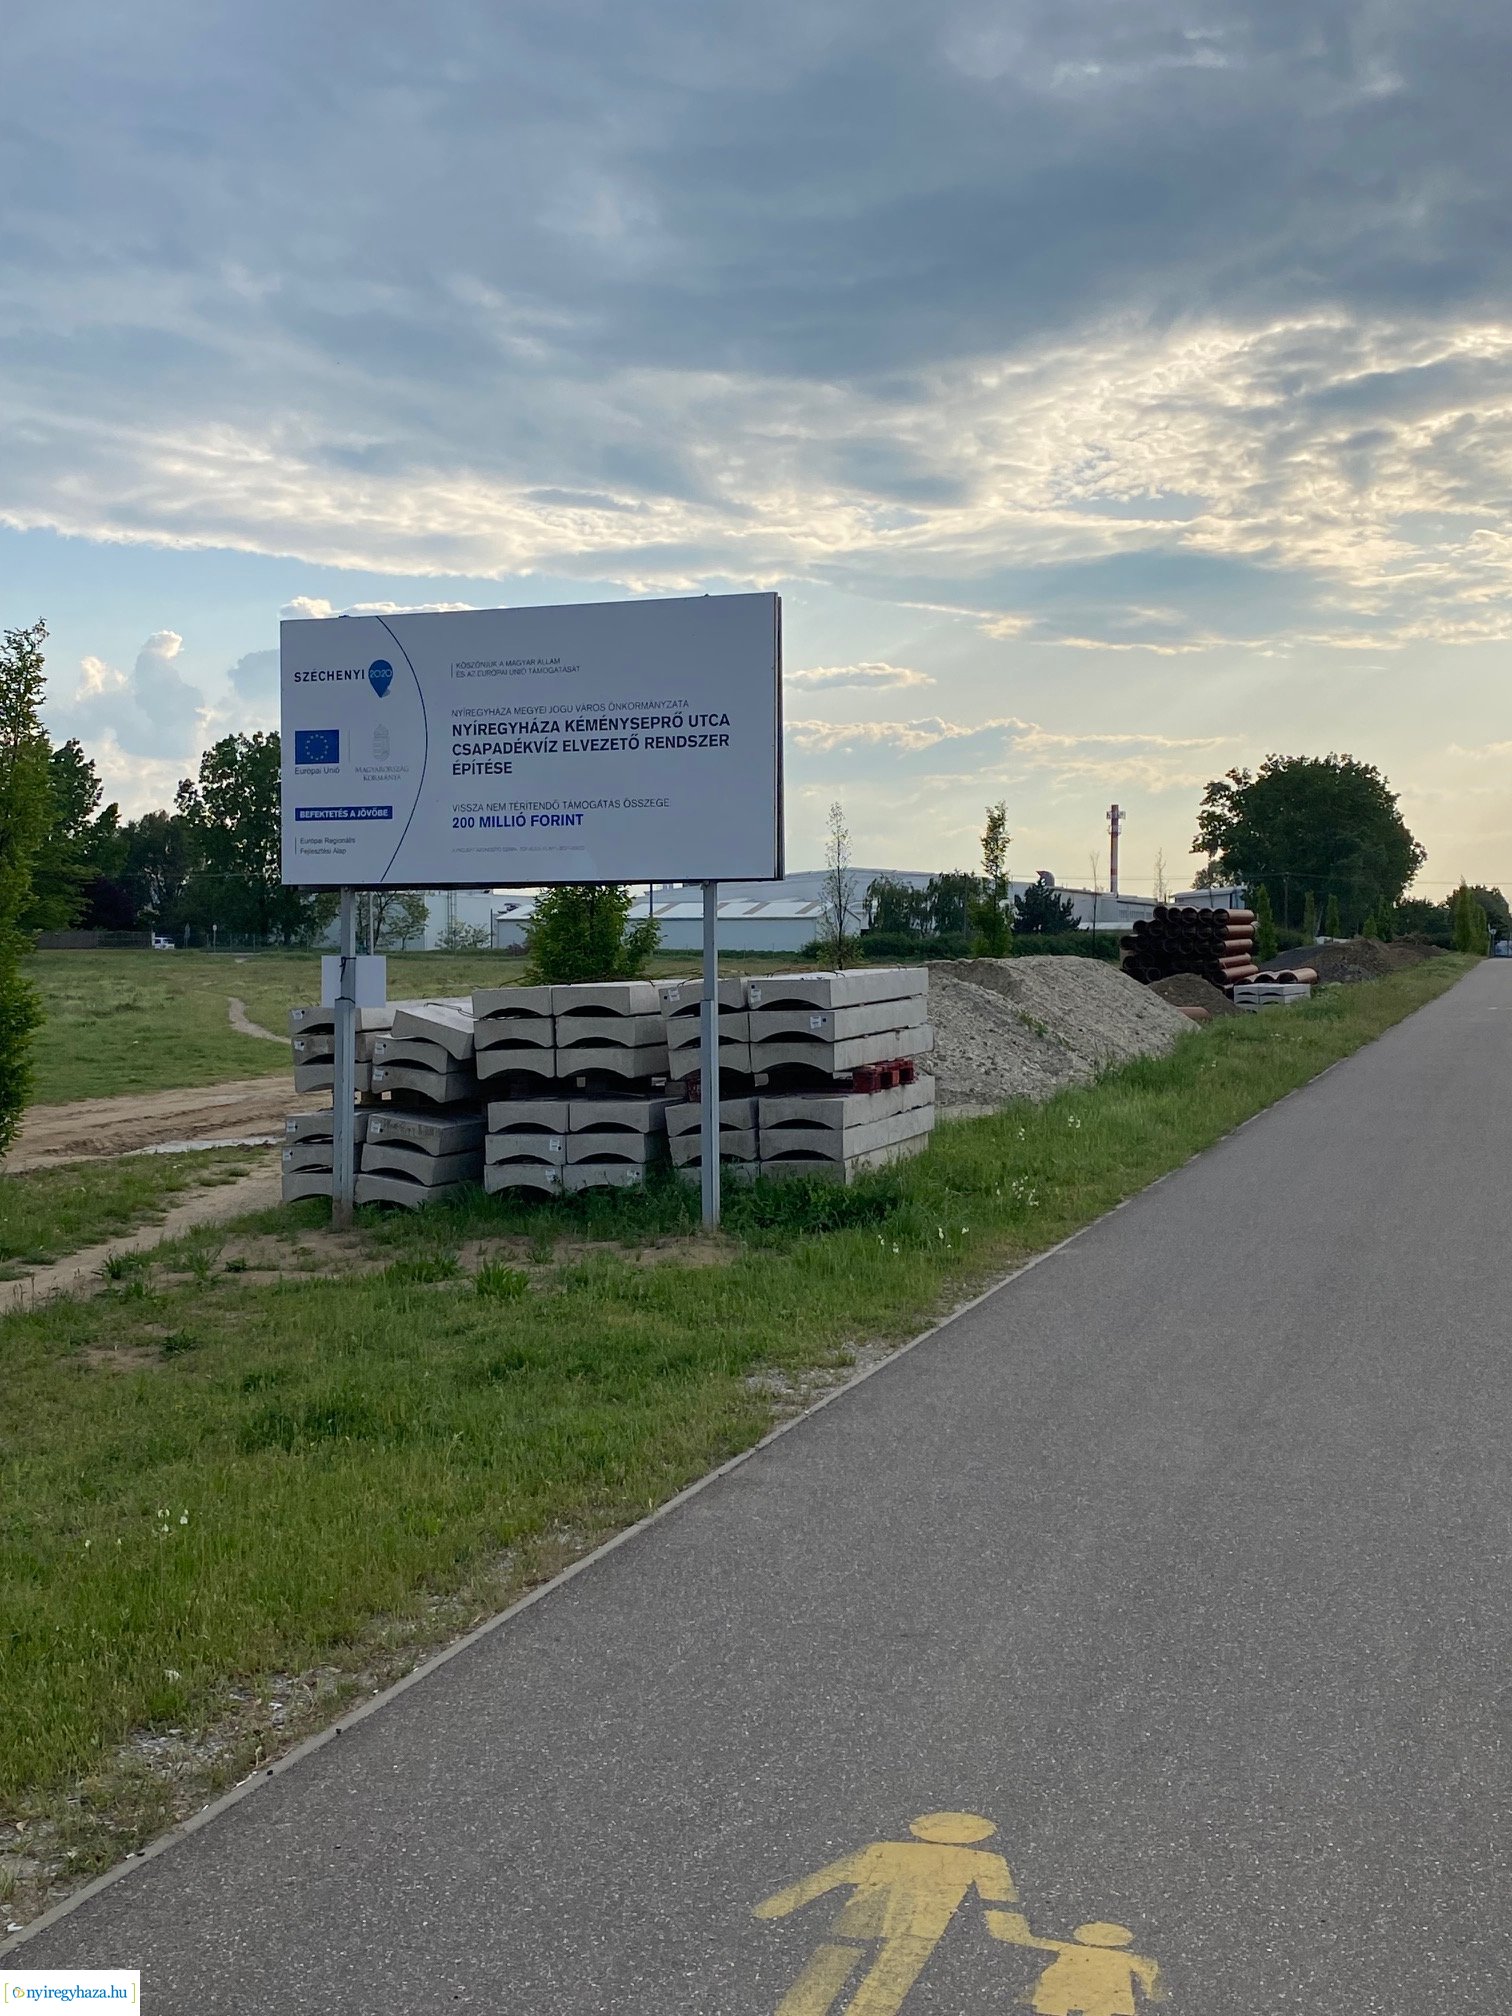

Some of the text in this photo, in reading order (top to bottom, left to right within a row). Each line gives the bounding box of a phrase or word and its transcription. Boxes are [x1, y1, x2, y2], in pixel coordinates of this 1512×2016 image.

[506, 658, 536, 667] MAGYAR
[294, 668, 393, 682] SZÉCHENYI 2020
[514, 705, 547, 715] MEGYEI
[452, 711, 730, 736] NYÍREGYHÁZA KÉMÉNYSEPRŐ UTCA
[452, 733, 730, 756] CSAPADÉKVÍZ ELVEZETŐ RENDSZER
[452, 758, 512, 775] ÉPÍTÉSE
[300, 809, 348, 819] BEFEKTETÉS
[349, 810, 356, 818] A
[452, 803, 484, 813] VISSZA
[486, 802, 507, 812] NEM
[452, 812, 584, 828] 200 MILLIÓ FORINT
